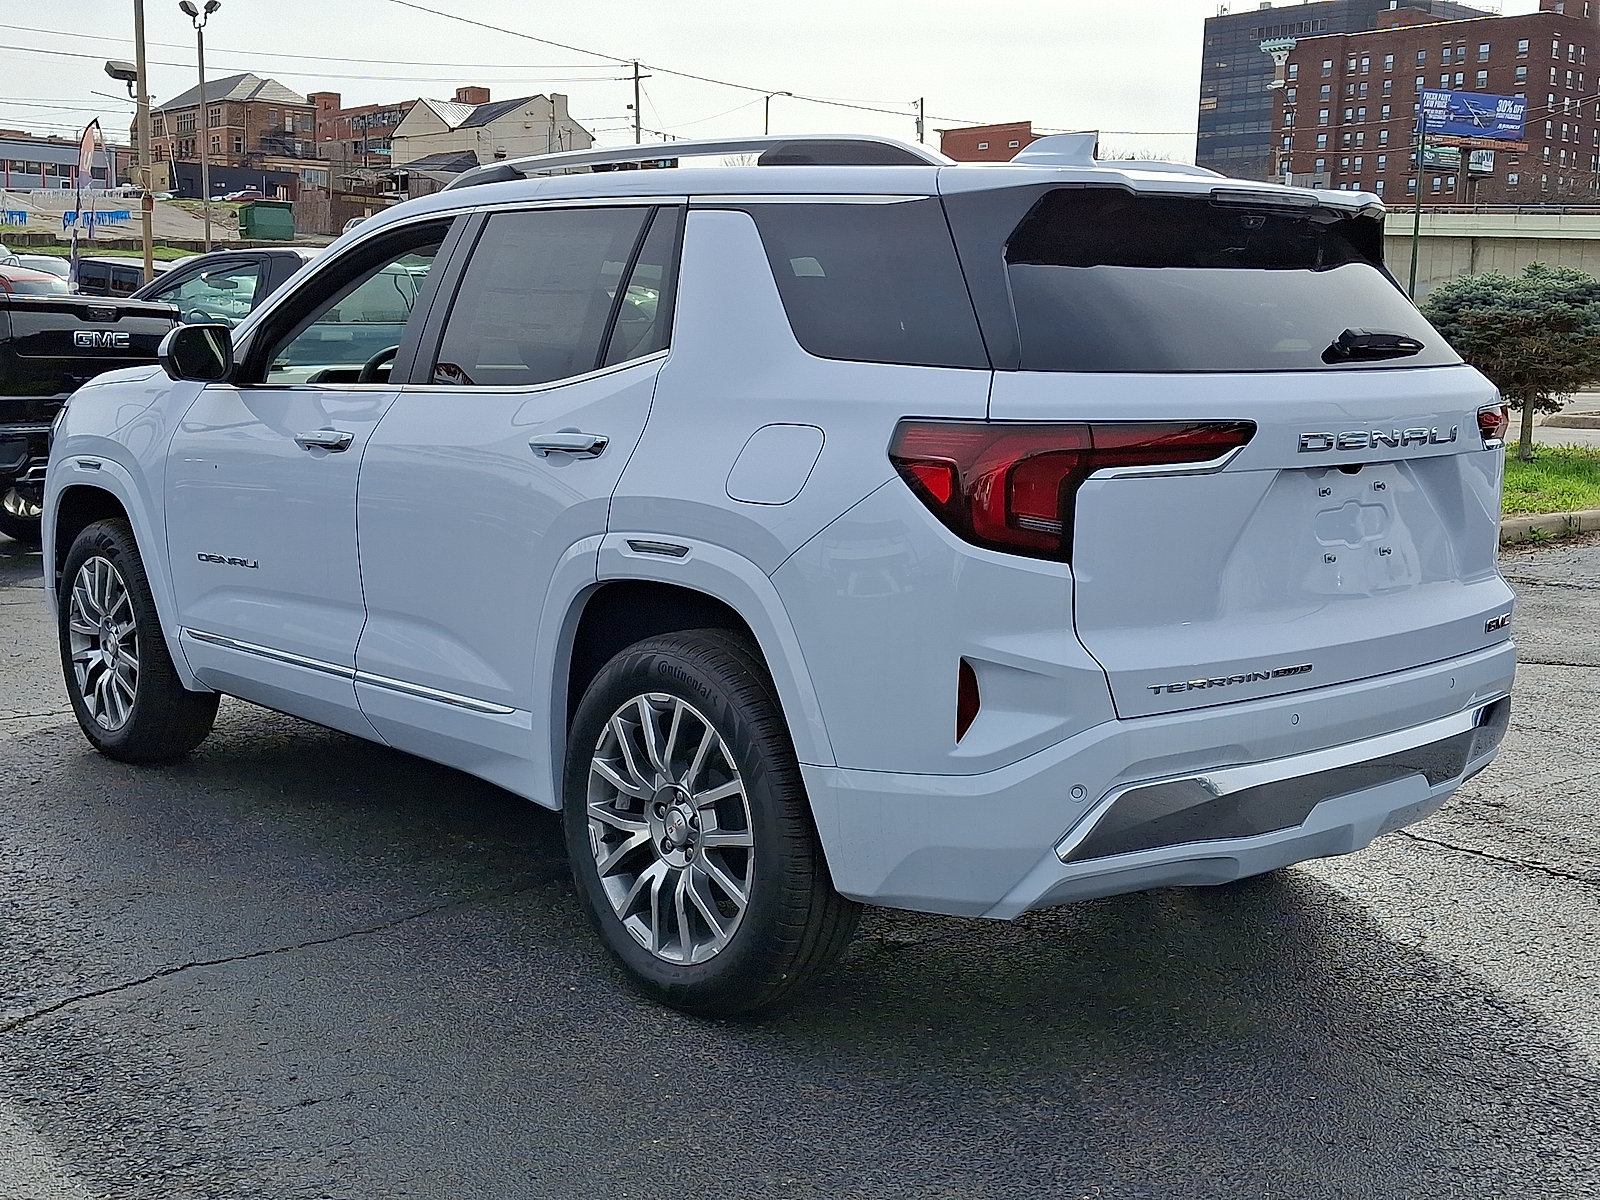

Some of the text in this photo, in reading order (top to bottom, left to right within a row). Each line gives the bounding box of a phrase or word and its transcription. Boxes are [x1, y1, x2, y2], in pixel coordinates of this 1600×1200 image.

[1496, 99, 1525, 114] 30% OFF
[73, 331, 130, 349] GMC
[1298, 424, 1458, 453] DENALI
[197, 552, 259, 569] DENALI
[657, 660, 712, 700] Continental
[1147, 671, 1270, 695] TERRAIN
